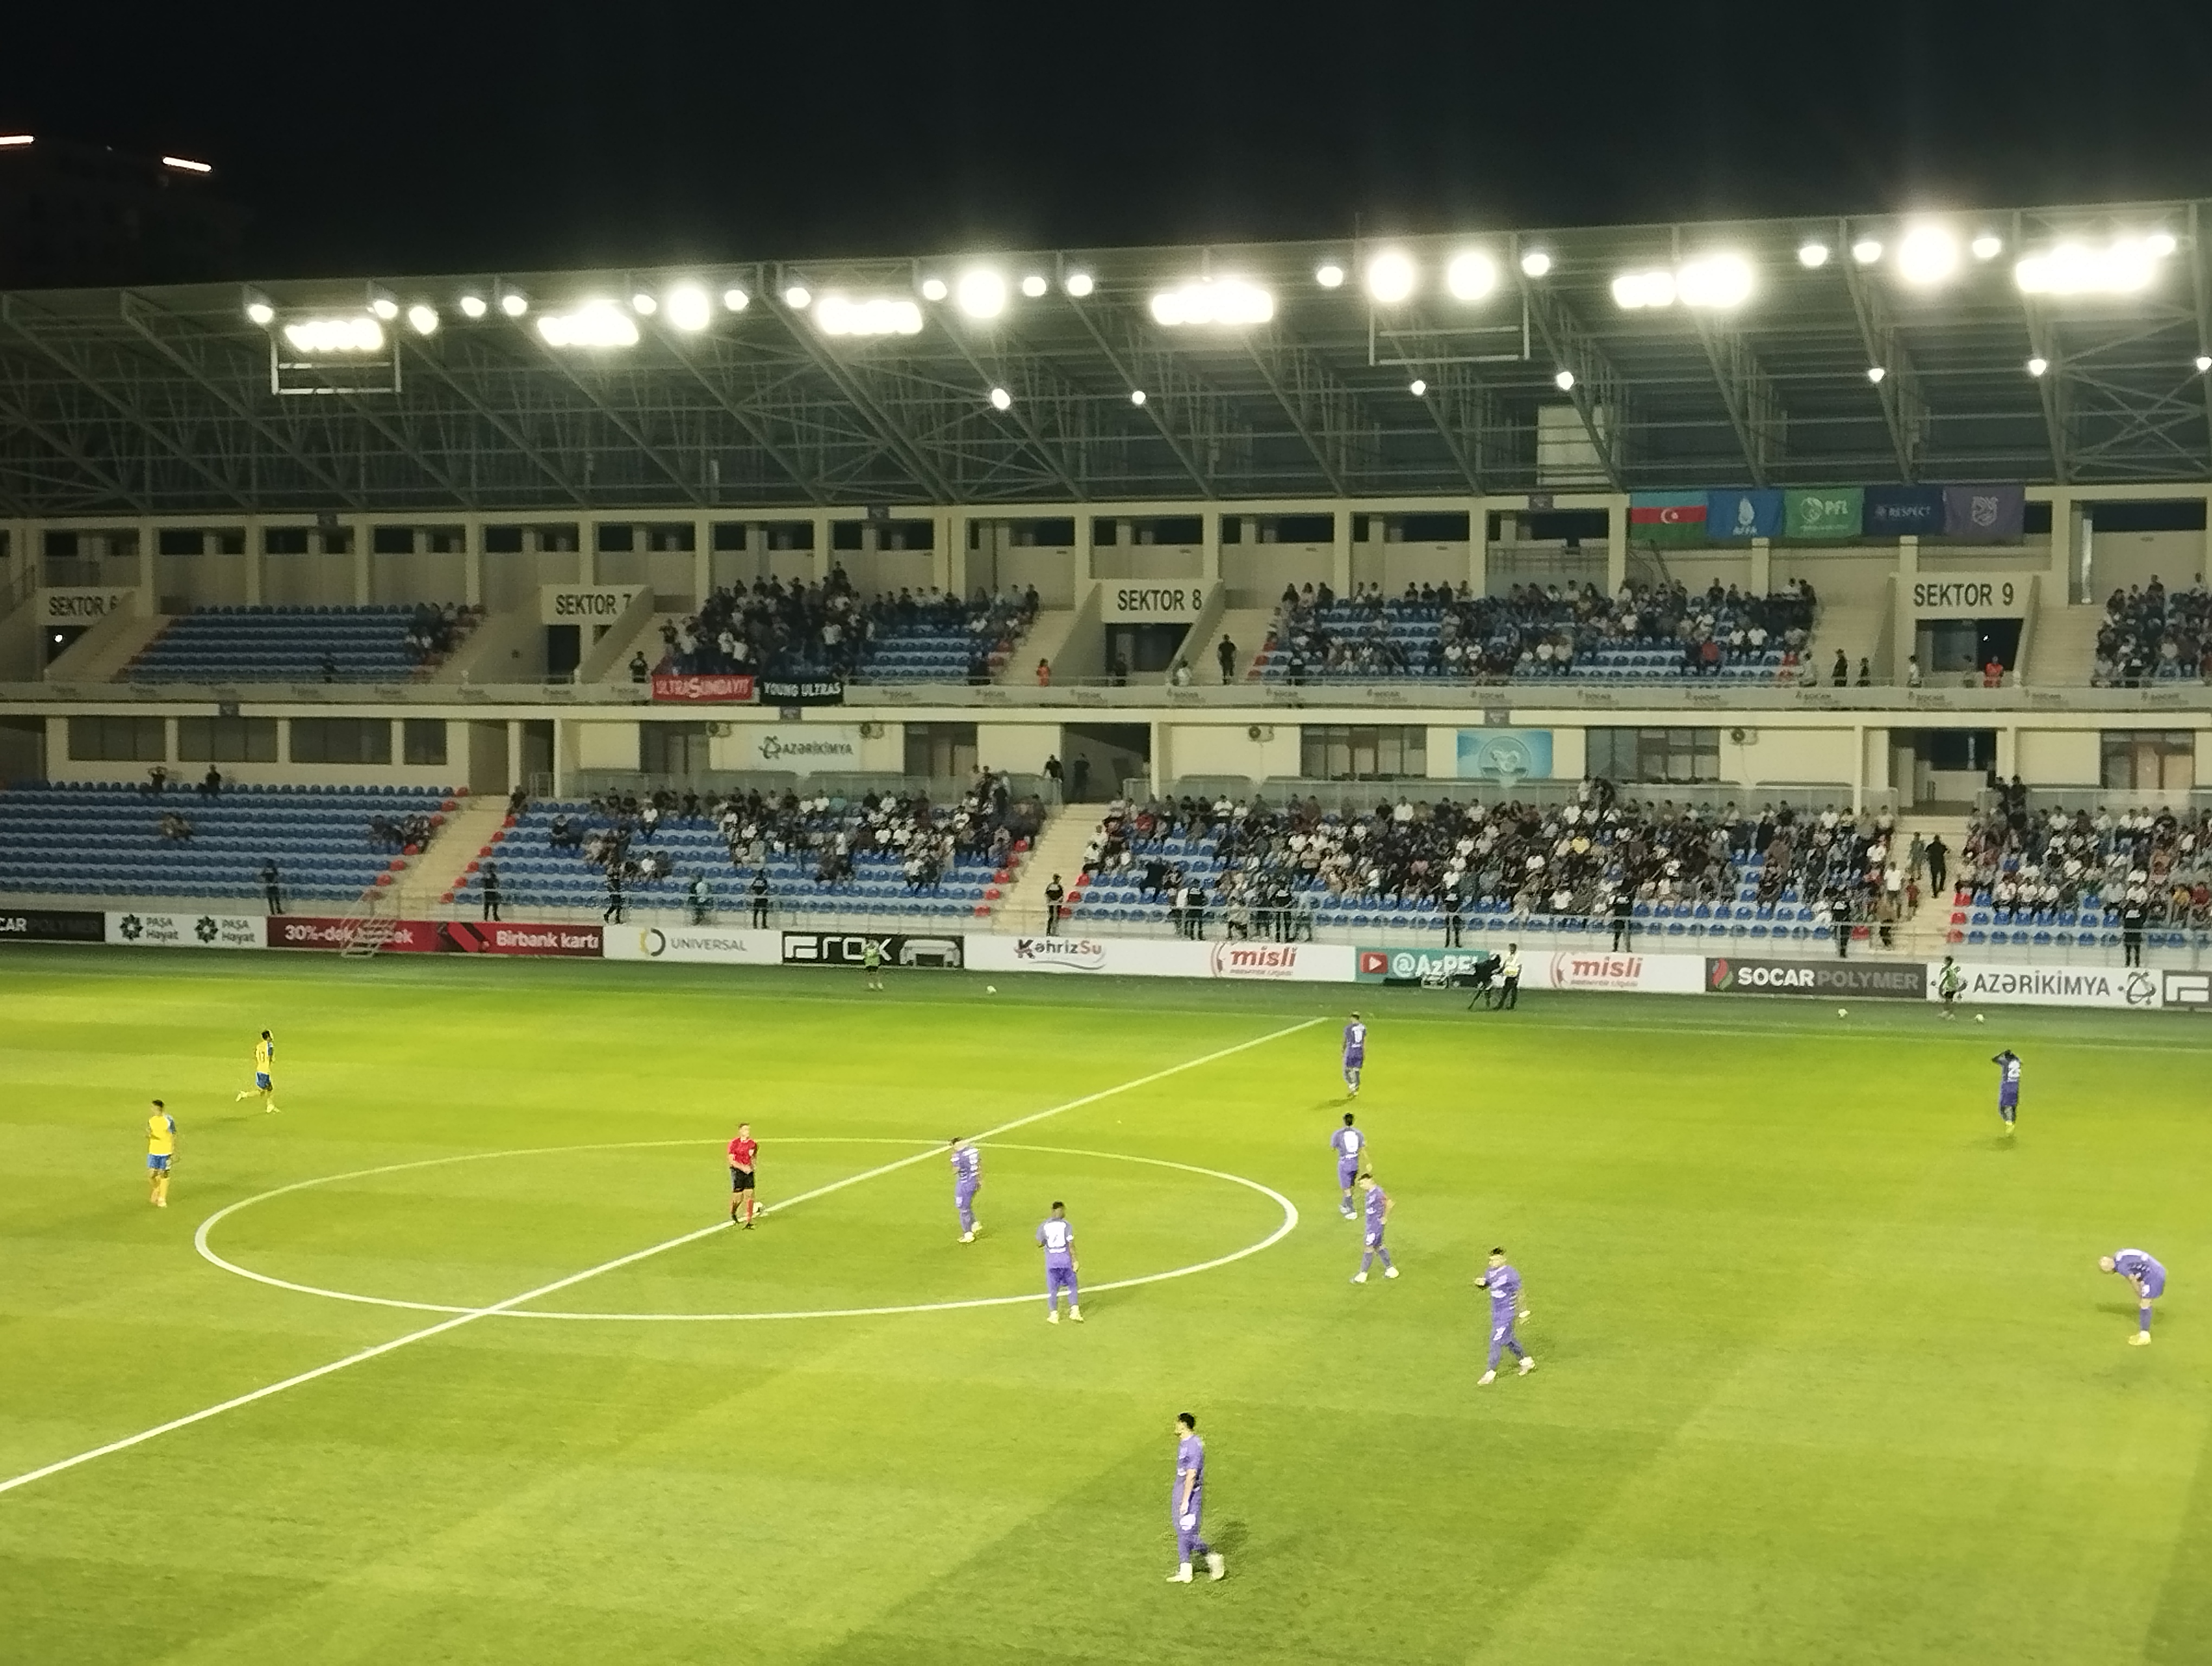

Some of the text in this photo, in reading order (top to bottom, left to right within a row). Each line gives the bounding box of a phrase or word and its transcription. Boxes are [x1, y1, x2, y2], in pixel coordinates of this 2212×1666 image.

[556, 593, 633, 615] SEKTOR 7
[1117, 588, 1203, 611] SEKTOR 8
[1913, 582, 2015, 607] SEKTOR 9
[49, 596, 107, 617] SEKTOR
[763, 682, 841, 697] YOUNG ULTRAS
[496, 930, 558, 948] Birbank
[671, 936, 748, 952] UNIVERSAL
[1230, 945, 1298, 967] misli
[1571, 956, 1643, 978] misli
[1737, 967, 1919, 990] SOCAR POLYMER
[1972, 970, 2111, 997] AZƏRİKİMYA
